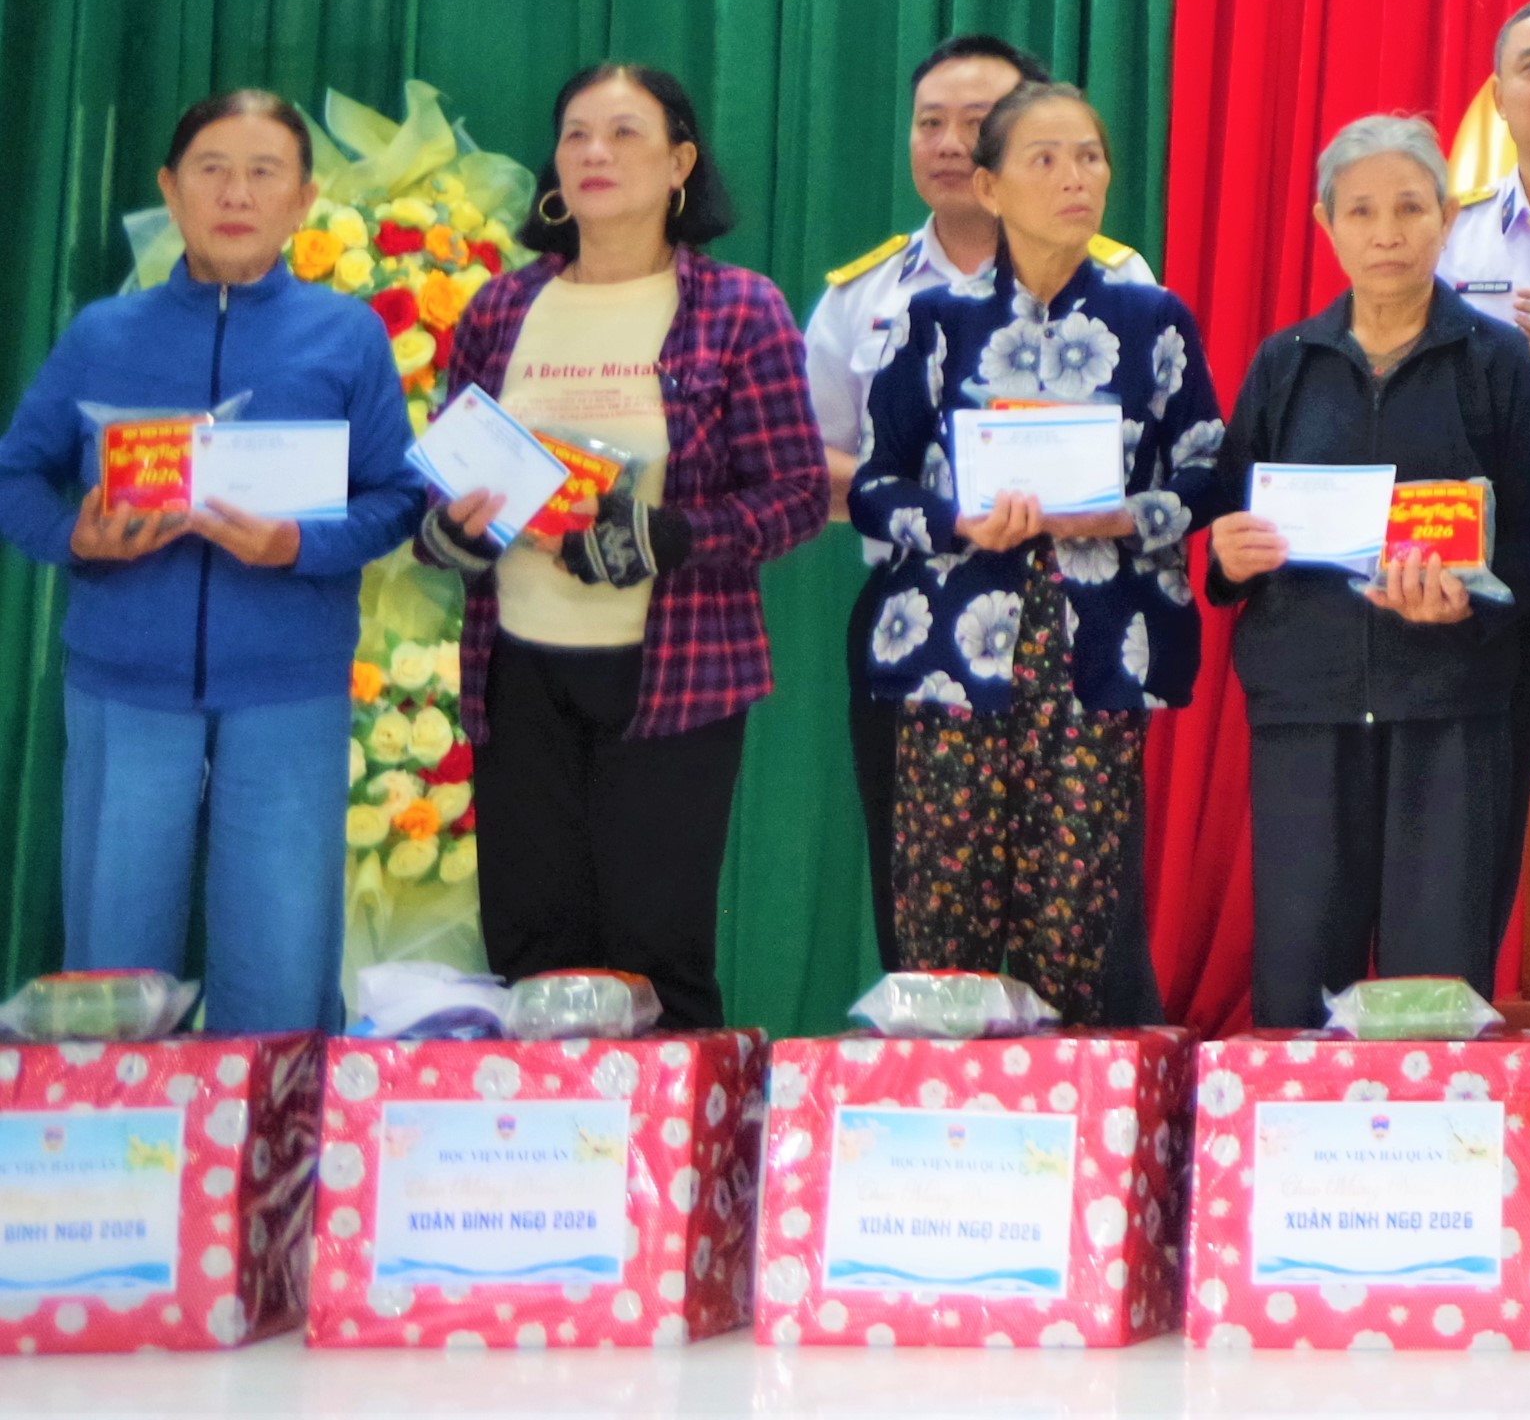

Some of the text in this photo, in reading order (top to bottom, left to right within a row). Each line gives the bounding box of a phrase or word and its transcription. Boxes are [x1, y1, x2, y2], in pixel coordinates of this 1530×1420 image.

[523, 364, 534, 379] A
[540, 364, 595, 379] Better
[1411, 524, 1454, 541] 2026
[1285, 1207, 1474, 1235] XUÂN BÍNH NGỌ 2026
